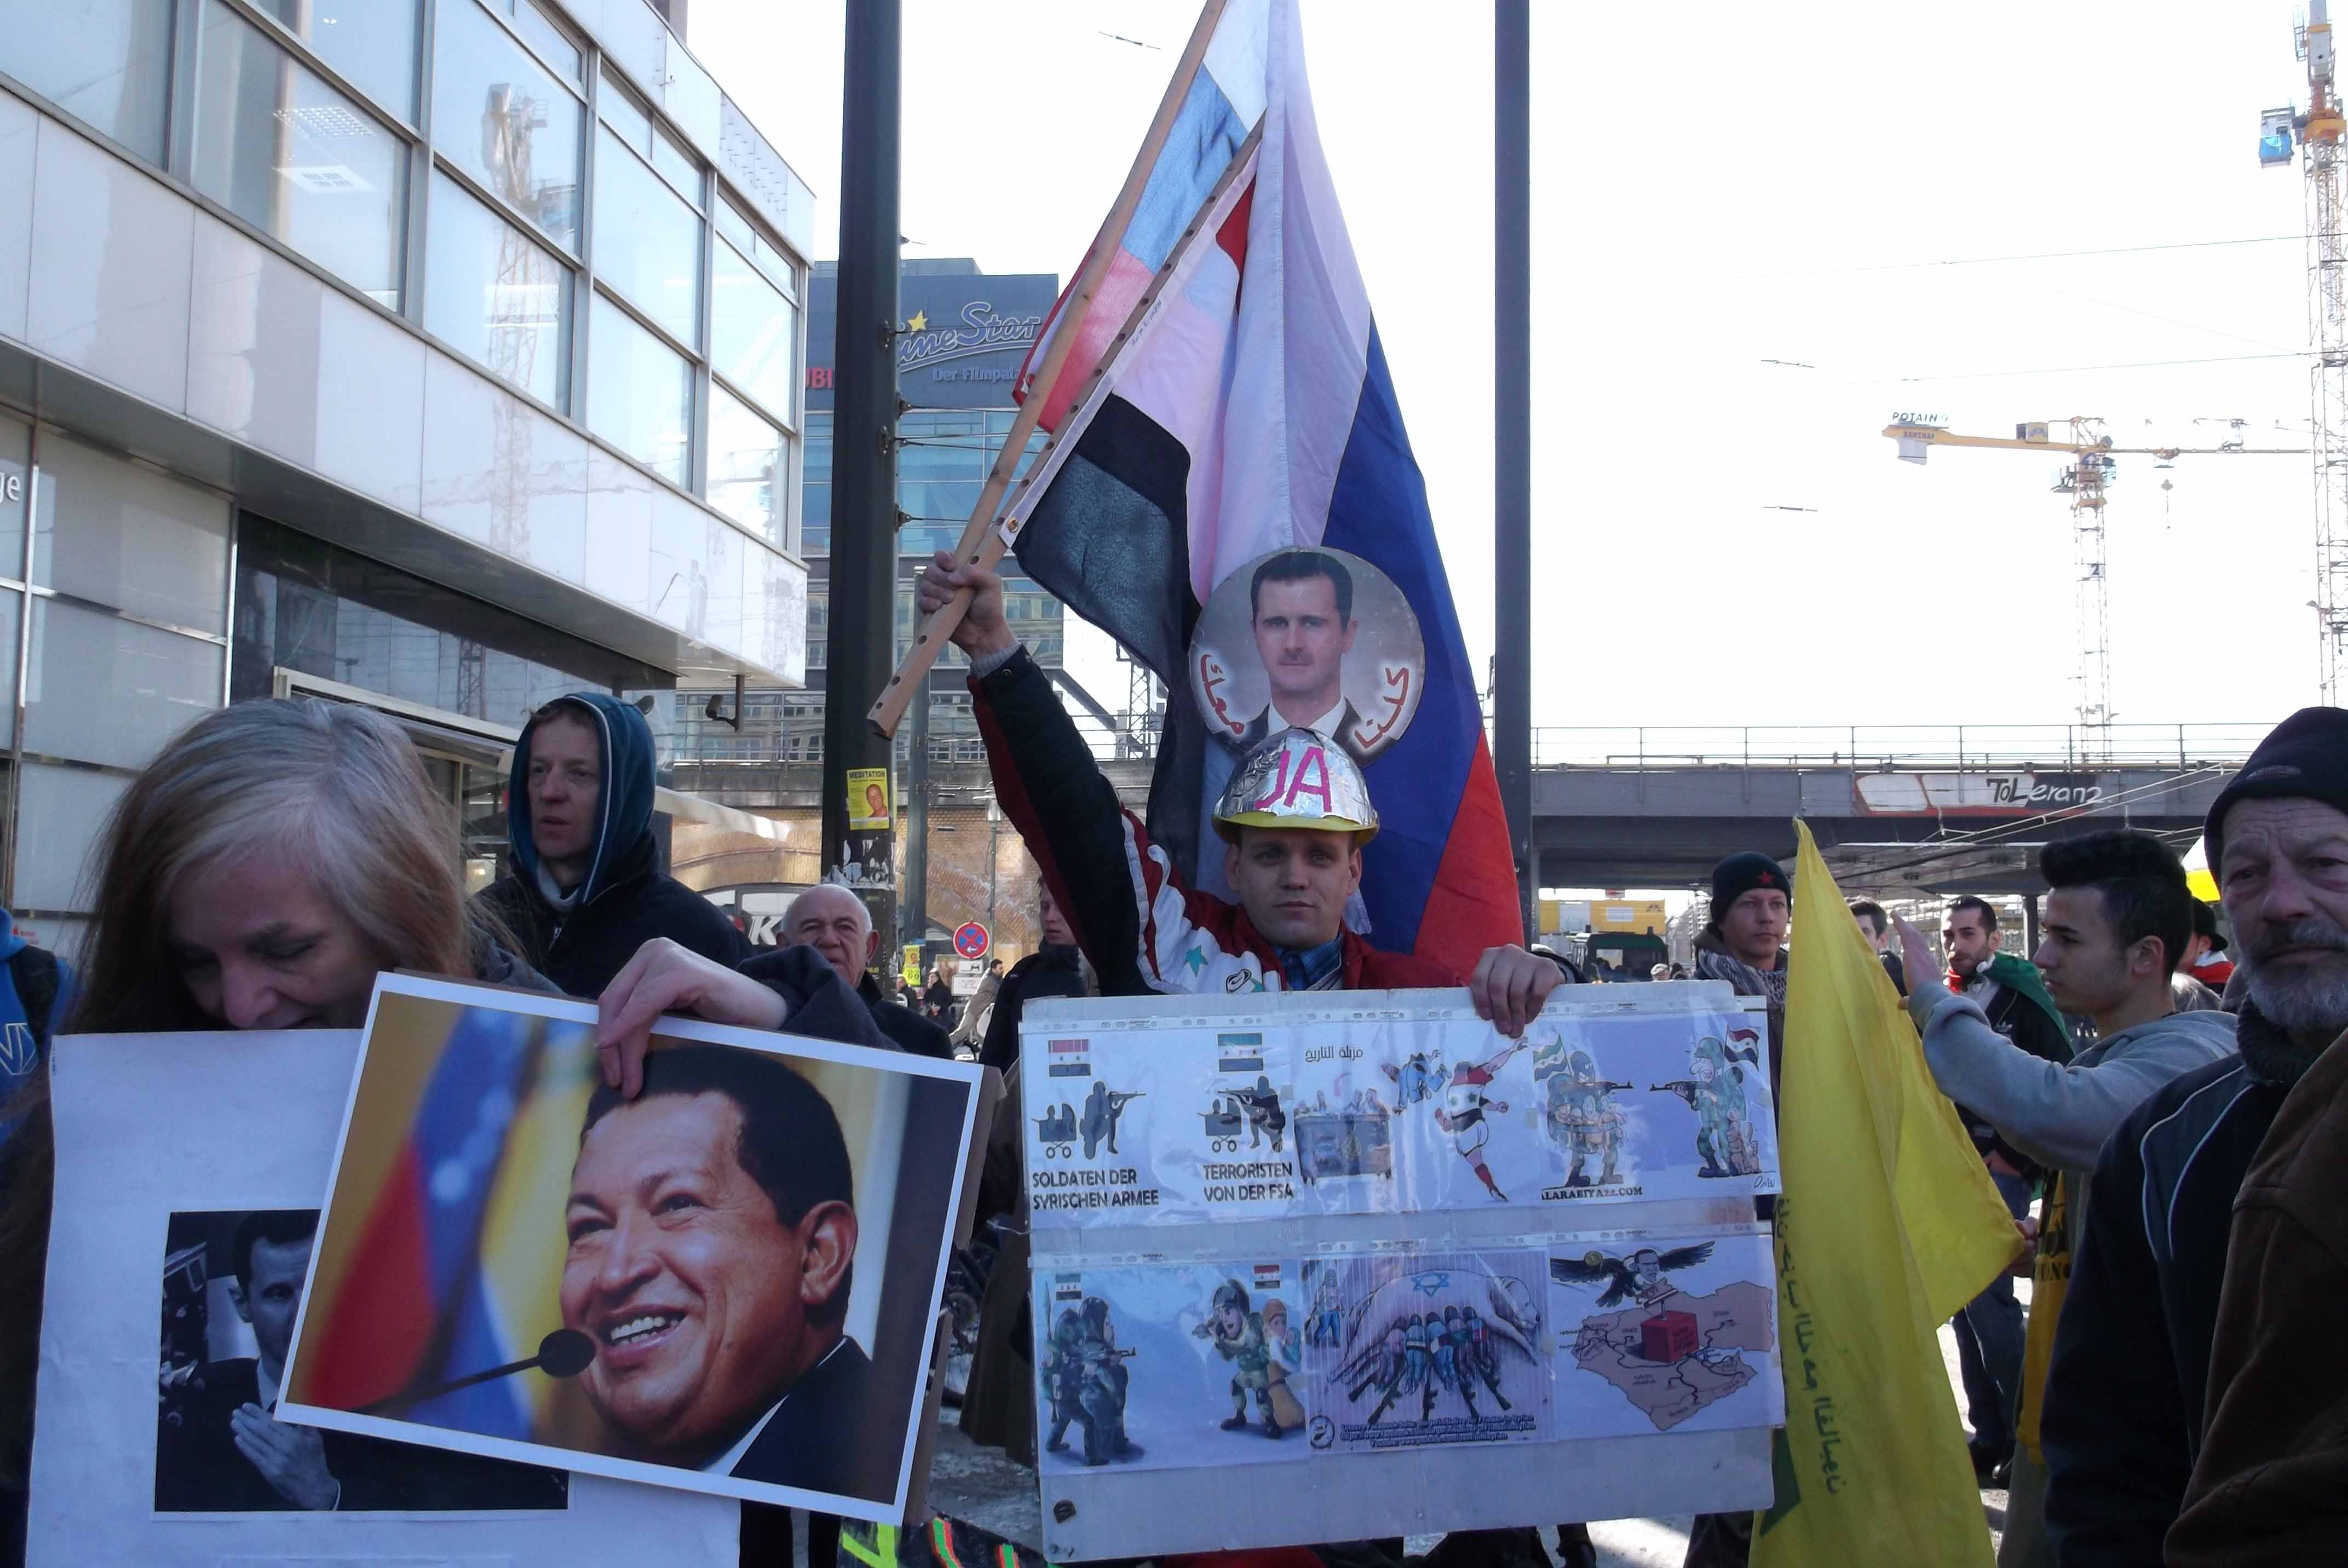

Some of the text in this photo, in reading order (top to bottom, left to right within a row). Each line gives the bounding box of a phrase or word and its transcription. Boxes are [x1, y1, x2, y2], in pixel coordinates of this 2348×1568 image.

[900, 302, 1040, 362] ineStar
[1892, 412, 1937, 422] POTAIN
[2091, 563, 2100, 575] 2
[849, 770, 885, 779] MEDITATION
[1255, 746, 1332, 812] JA
[1305, 1045, 1363, 1063] مزبلة التاريخ
[1032, 1168, 1137, 1188] SOLDATEN DER
[1202, 1161, 1293, 1180] TERRORISTEN
[1033, 1189, 1159, 1210] SYRISCHEN ARMEE
[1204, 1182, 1294, 1202] VON DER FSA
